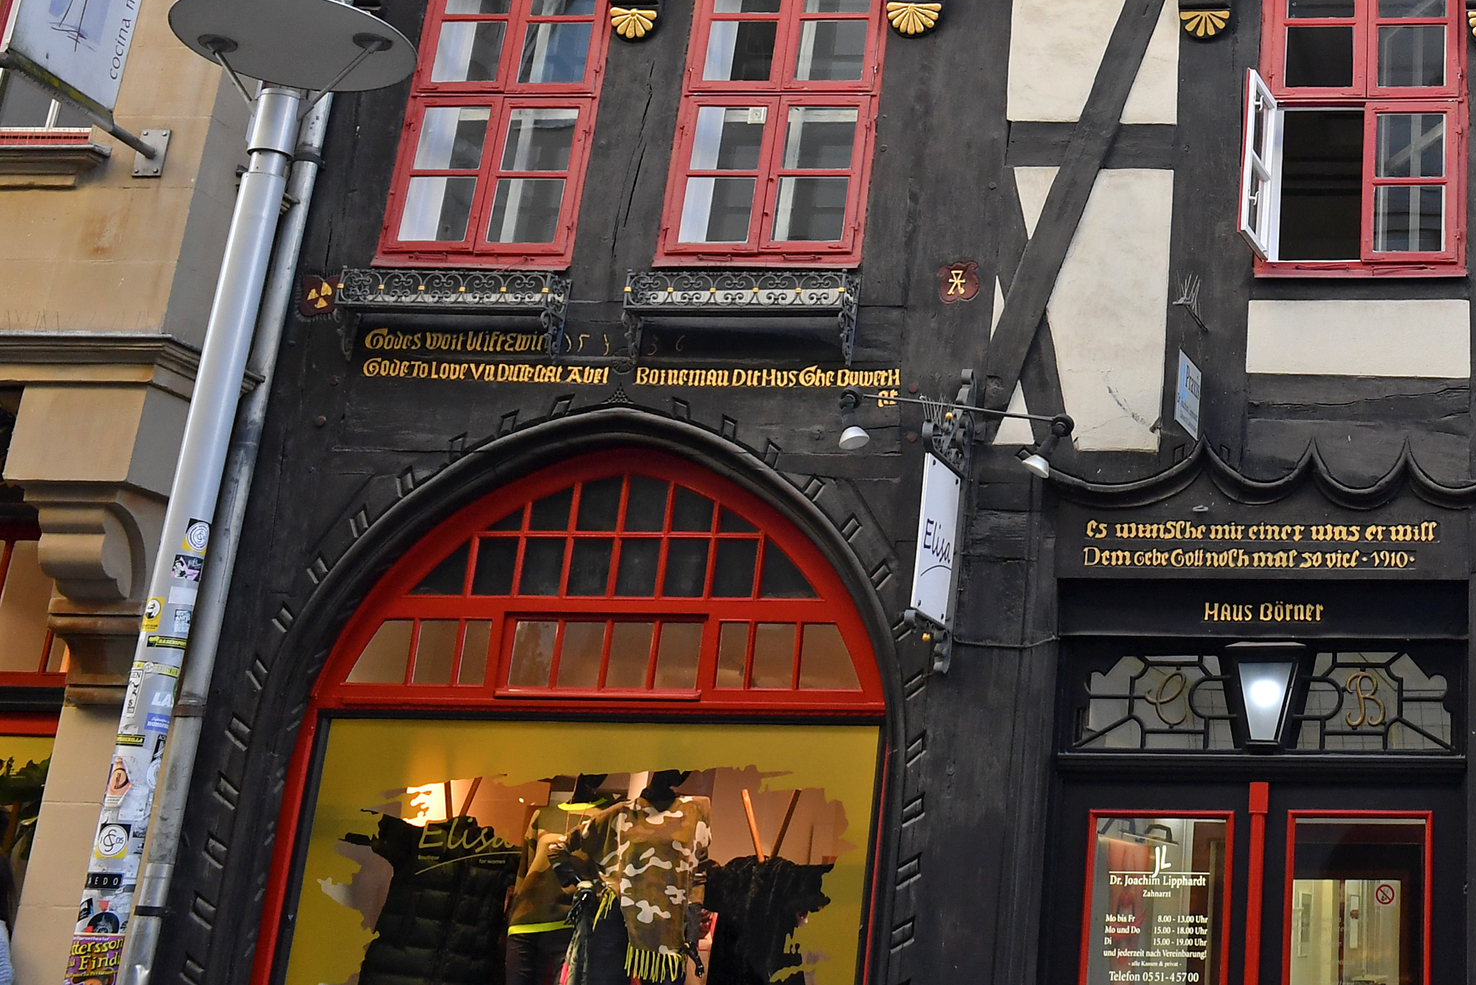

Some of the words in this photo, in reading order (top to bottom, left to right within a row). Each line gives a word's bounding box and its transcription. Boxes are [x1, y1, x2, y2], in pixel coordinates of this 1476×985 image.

[109, 0, 137, 81] cocina
[1209, 522, 1245, 540] mir
[1310, 523, 1361, 542] was
[1365, 524, 1387, 541] er
[923, 518, 951, 563] Elisa
[1083, 547, 1132, 567] Dem
[1170, 548, 1204, 567] Gott
[1259, 600, 1324, 622] Börner
[418, 818, 514, 853] Elisa
[1109, 875, 1123, 885] Dr.
[1124, 875, 1160, 887] Joachim
[1162, 875, 1206, 888] Lipphardt
[1142, 889, 1171, 897] Zahnarzt
[1105, 914, 1116, 923] Mo
[1117, 914, 1127, 923] bis
[1128, 914, 1135, 923] Fr
[1157, 914, 1171, 923] 8.00
[1177, 914, 1194, 923] 13.00
[1195, 914, 1208, 923] Uhr
[1104, 925, 1115, 934] Mo
[1117, 925, 1129, 934] und
[1131, 925, 1140, 934] Do
[1154, 925, 1171, 934] 15.00
[1195, 925, 1208, 934] Uhr
[1104, 937, 1112, 946] Di
[1153, 937, 1171, 946] 15.00
[1194, 937, 1207, 946] Uhr
[1103, 948, 1116, 956] und
[1117, 948, 1145, 958] jederzeit
[1145, 949, 1161, 957] nach
[1162, 949, 1207, 960] Vereinbarung!
[1109, 971, 1141, 982] Telefon
